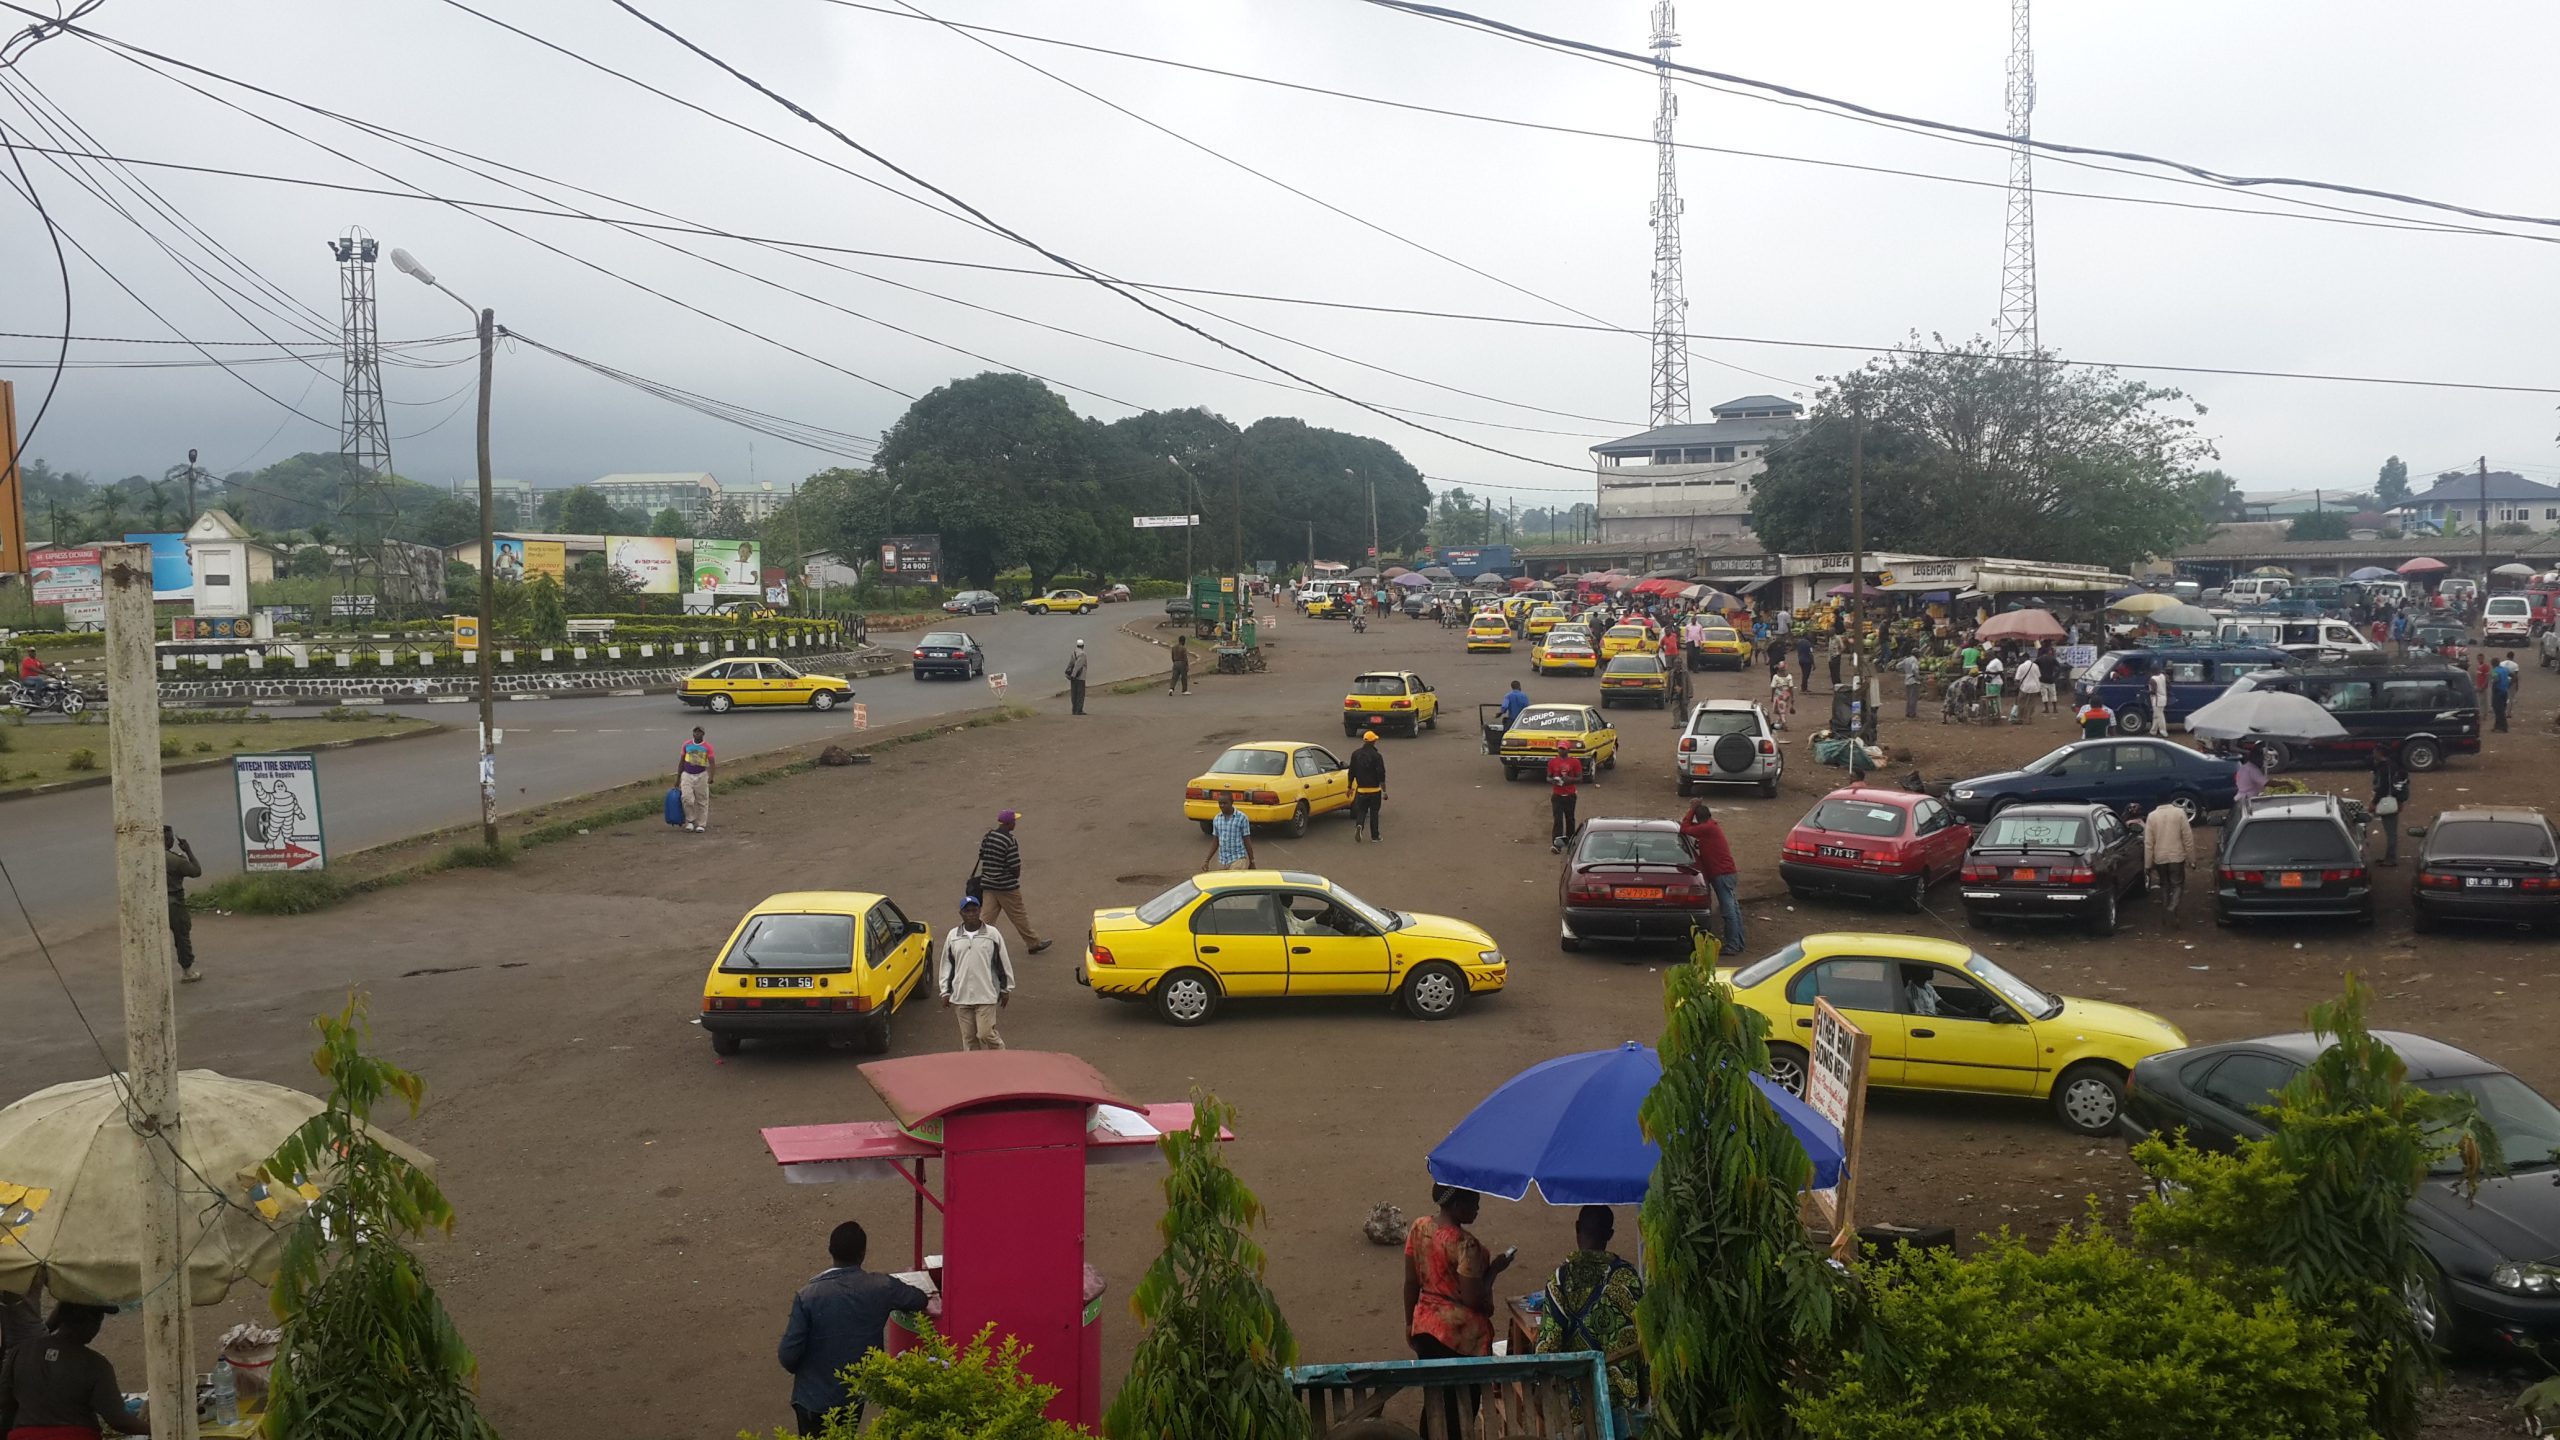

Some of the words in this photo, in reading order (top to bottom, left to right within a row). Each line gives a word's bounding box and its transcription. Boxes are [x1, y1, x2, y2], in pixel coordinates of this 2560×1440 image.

[1821, 556, 1849, 568] BUEA
[1912, 564, 1957, 577] LEGENDARY
[1522, 711, 1555, 724] CHOUPO
[238, 761, 263, 771] HITECH
[264, 761, 279, 771] TIRE
[279, 760, 312, 771] SERVICES
[757, 977, 769, 988] 19
[778, 977, 789, 988] 21
[1815, 1040, 1834, 1073] SONS
